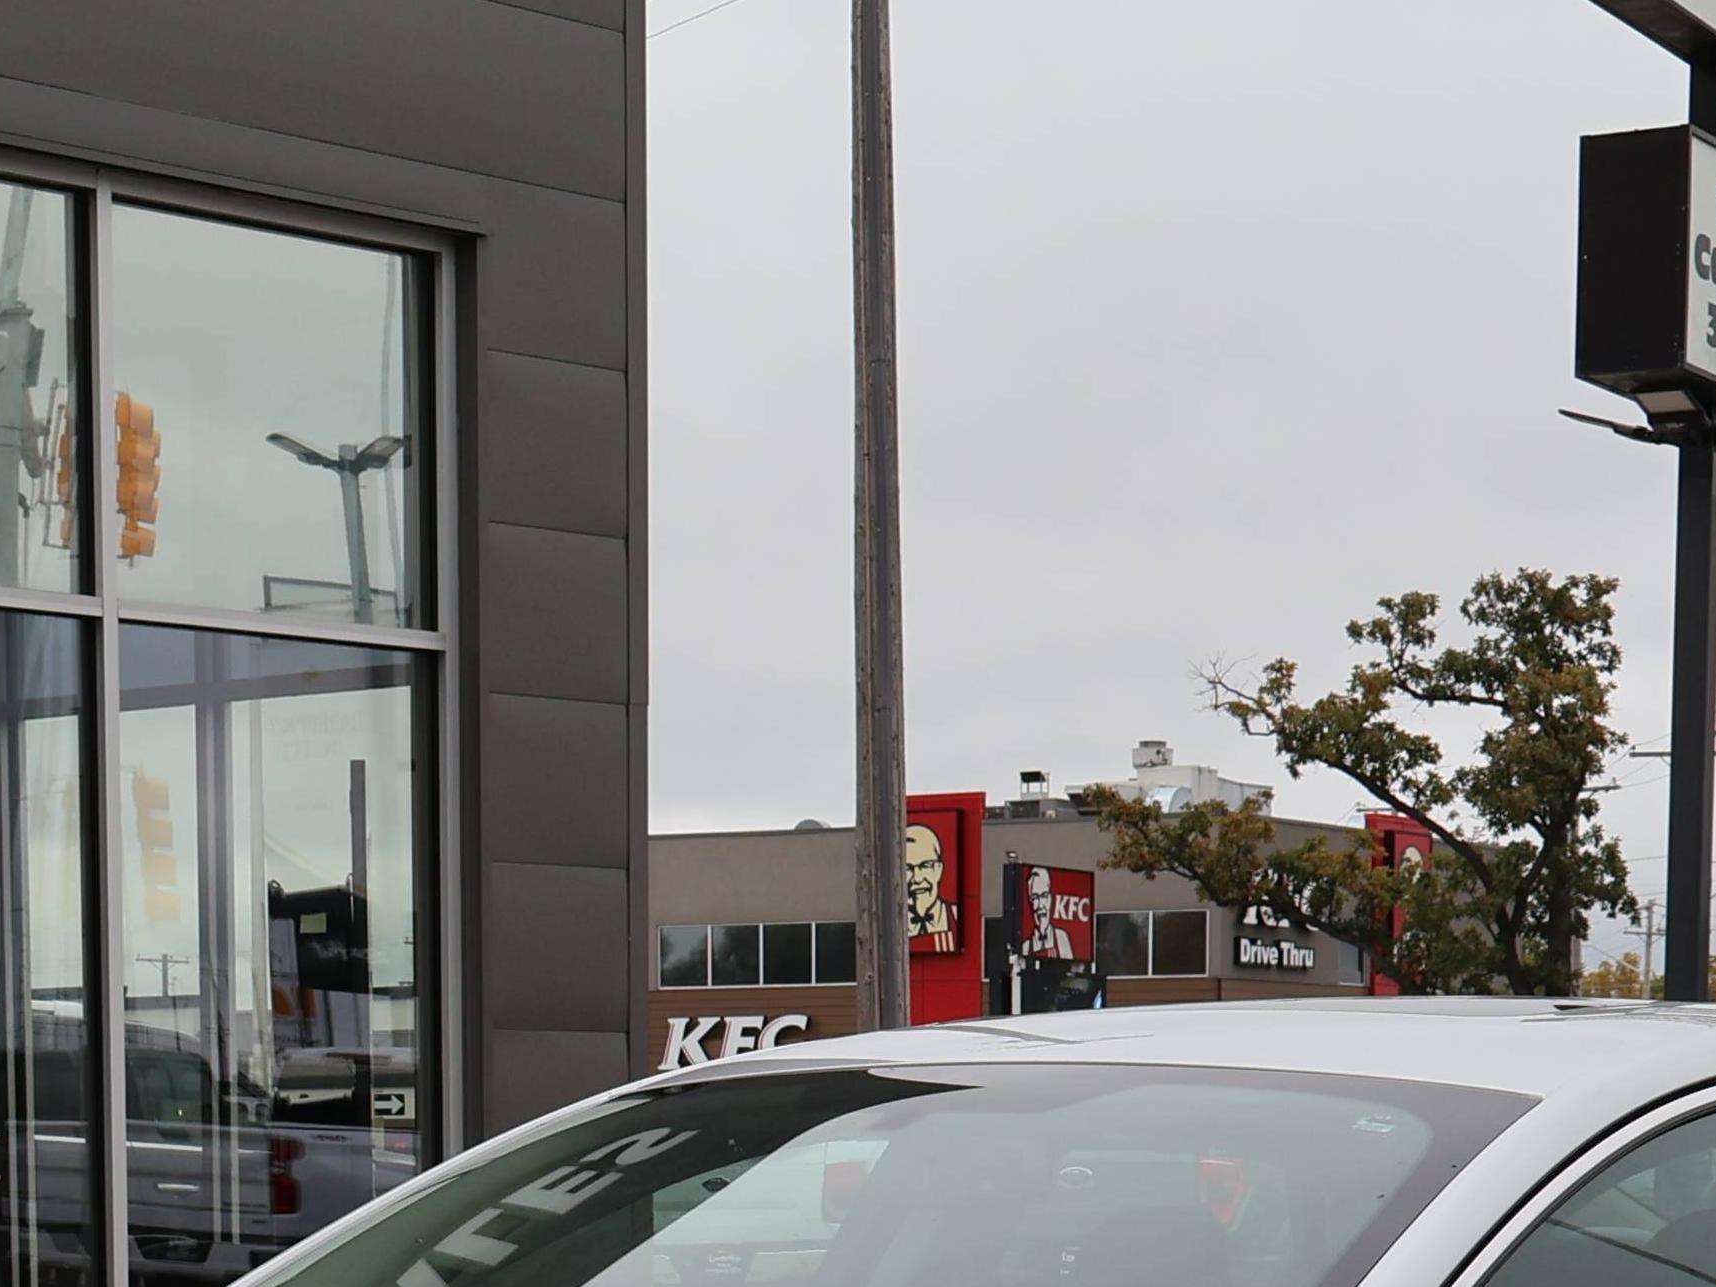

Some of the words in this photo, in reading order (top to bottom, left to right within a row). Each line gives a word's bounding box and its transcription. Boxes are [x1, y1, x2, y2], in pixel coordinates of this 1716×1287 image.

[1053, 894, 1090, 923] KFC
[1240, 938, 1279, 965] Drive
[1280, 941, 1314, 967] Thru
[657, 1014, 808, 1070] KFC
